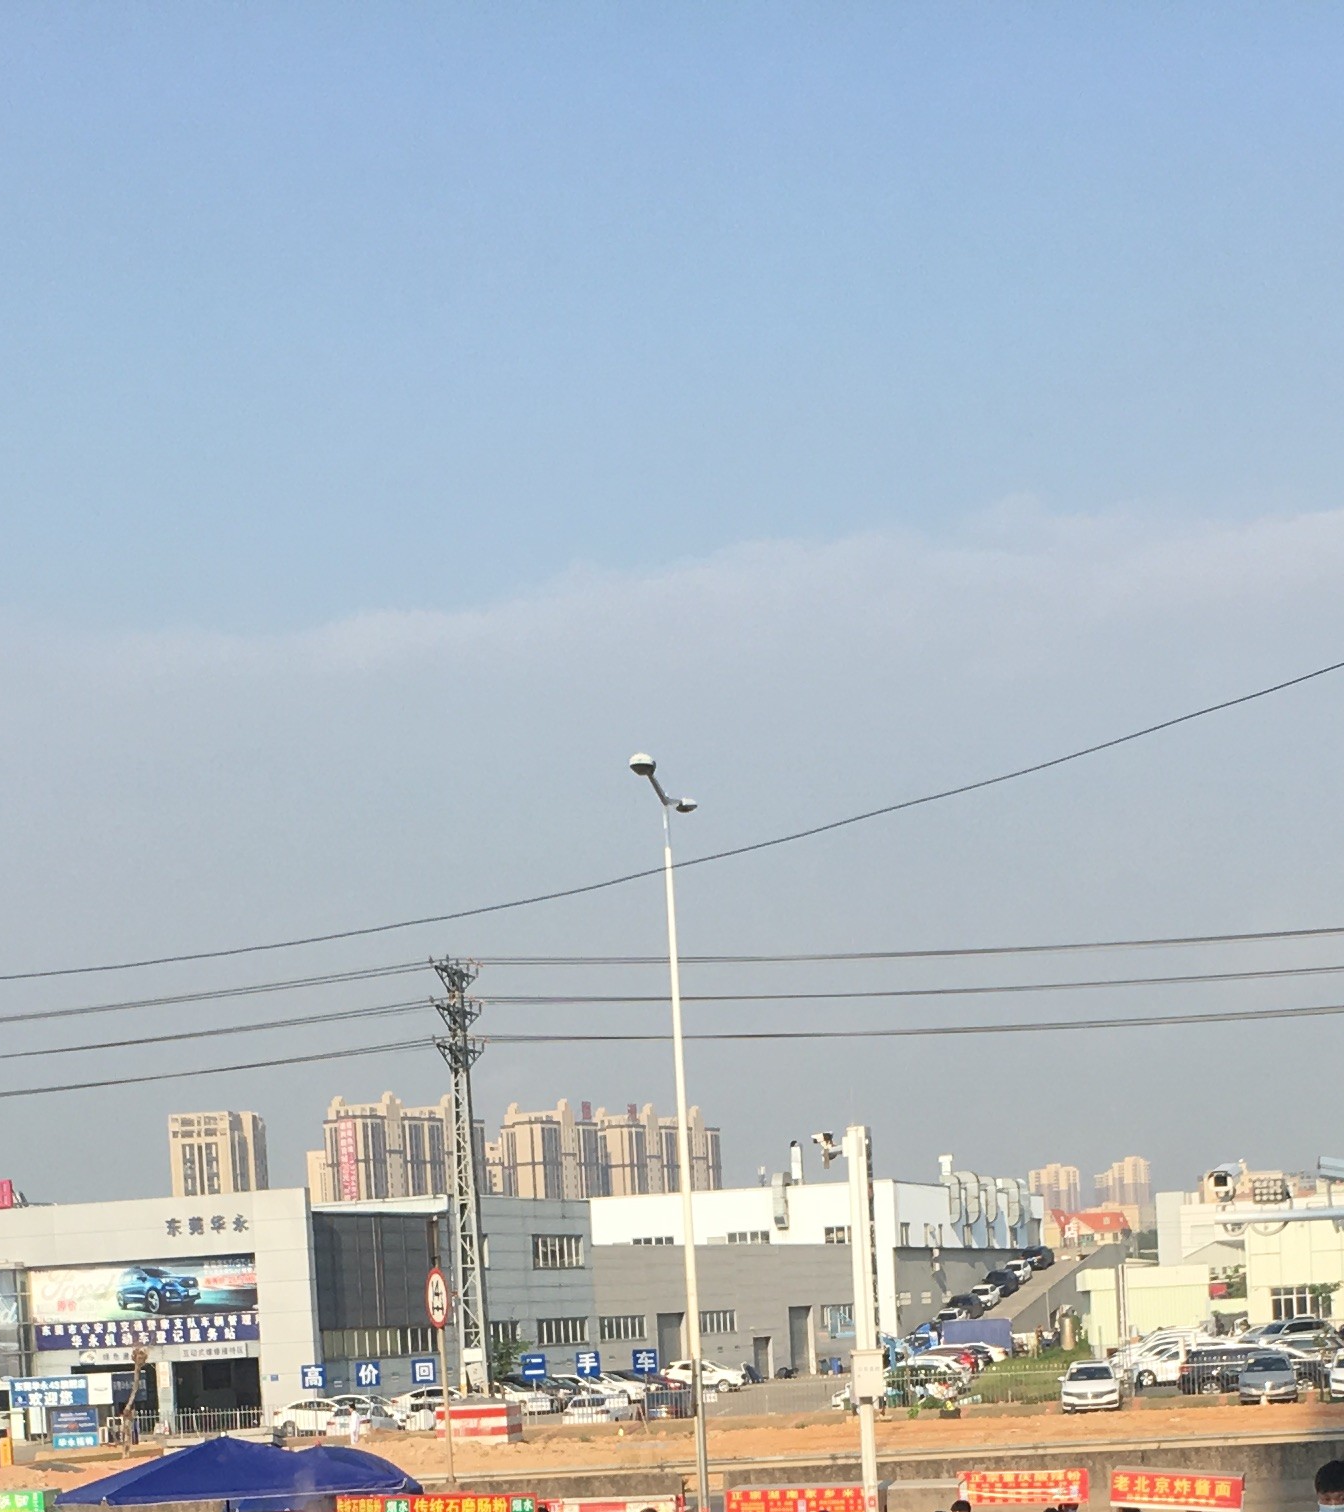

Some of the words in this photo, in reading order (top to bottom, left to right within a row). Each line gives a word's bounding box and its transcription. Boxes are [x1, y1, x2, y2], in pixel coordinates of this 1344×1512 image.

[165, 1213, 249, 1237] 东莞华永
[1113, 1474, 1232, 1497] 老北京炸酱面
